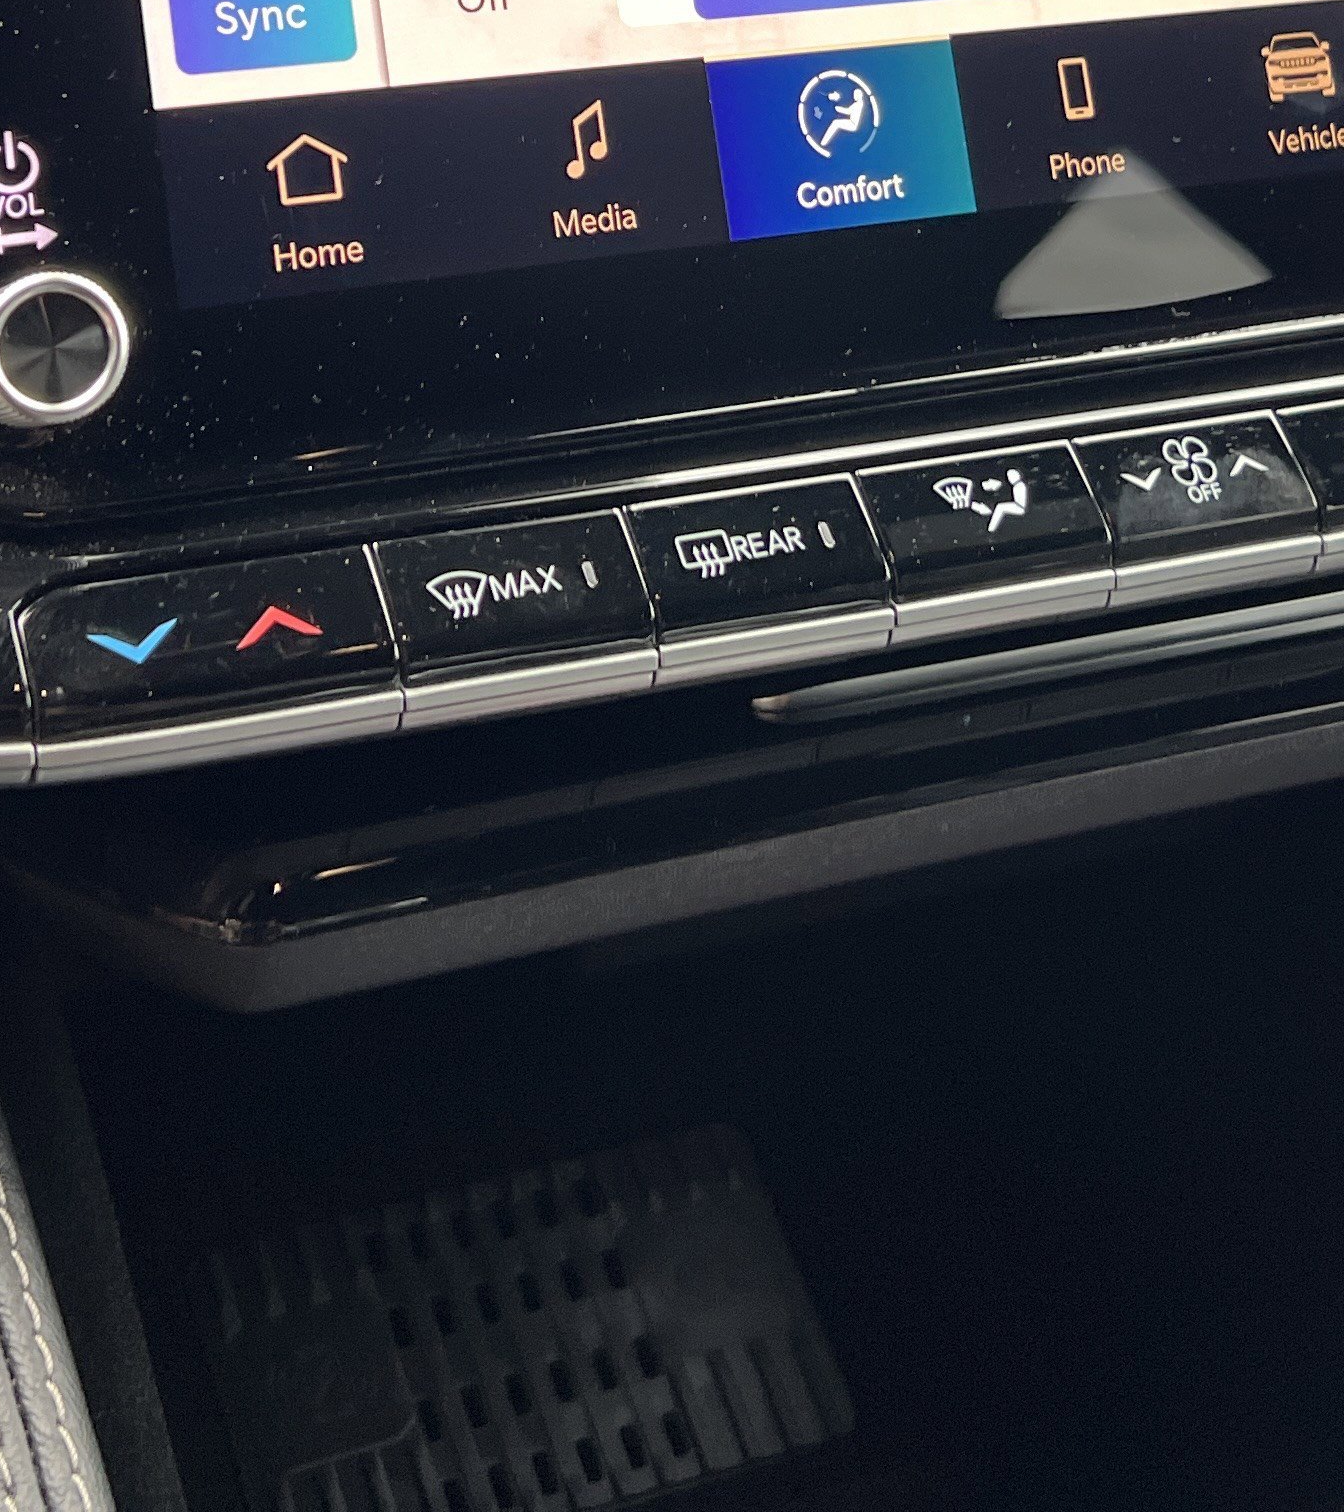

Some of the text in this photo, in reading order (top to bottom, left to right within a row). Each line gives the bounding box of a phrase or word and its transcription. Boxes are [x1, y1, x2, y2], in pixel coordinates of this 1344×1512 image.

[213, 0, 309, 42] Sync
[1048, 149, 1127, 181] Phone
[795, 172, 905, 210] Comfort
[552, 203, 639, 239] Media
[272, 238, 365, 274] Home
[1187, 482, 1224, 506] OFF
[733, 525, 807, 564] REAR
[488, 563, 564, 604] MAX
